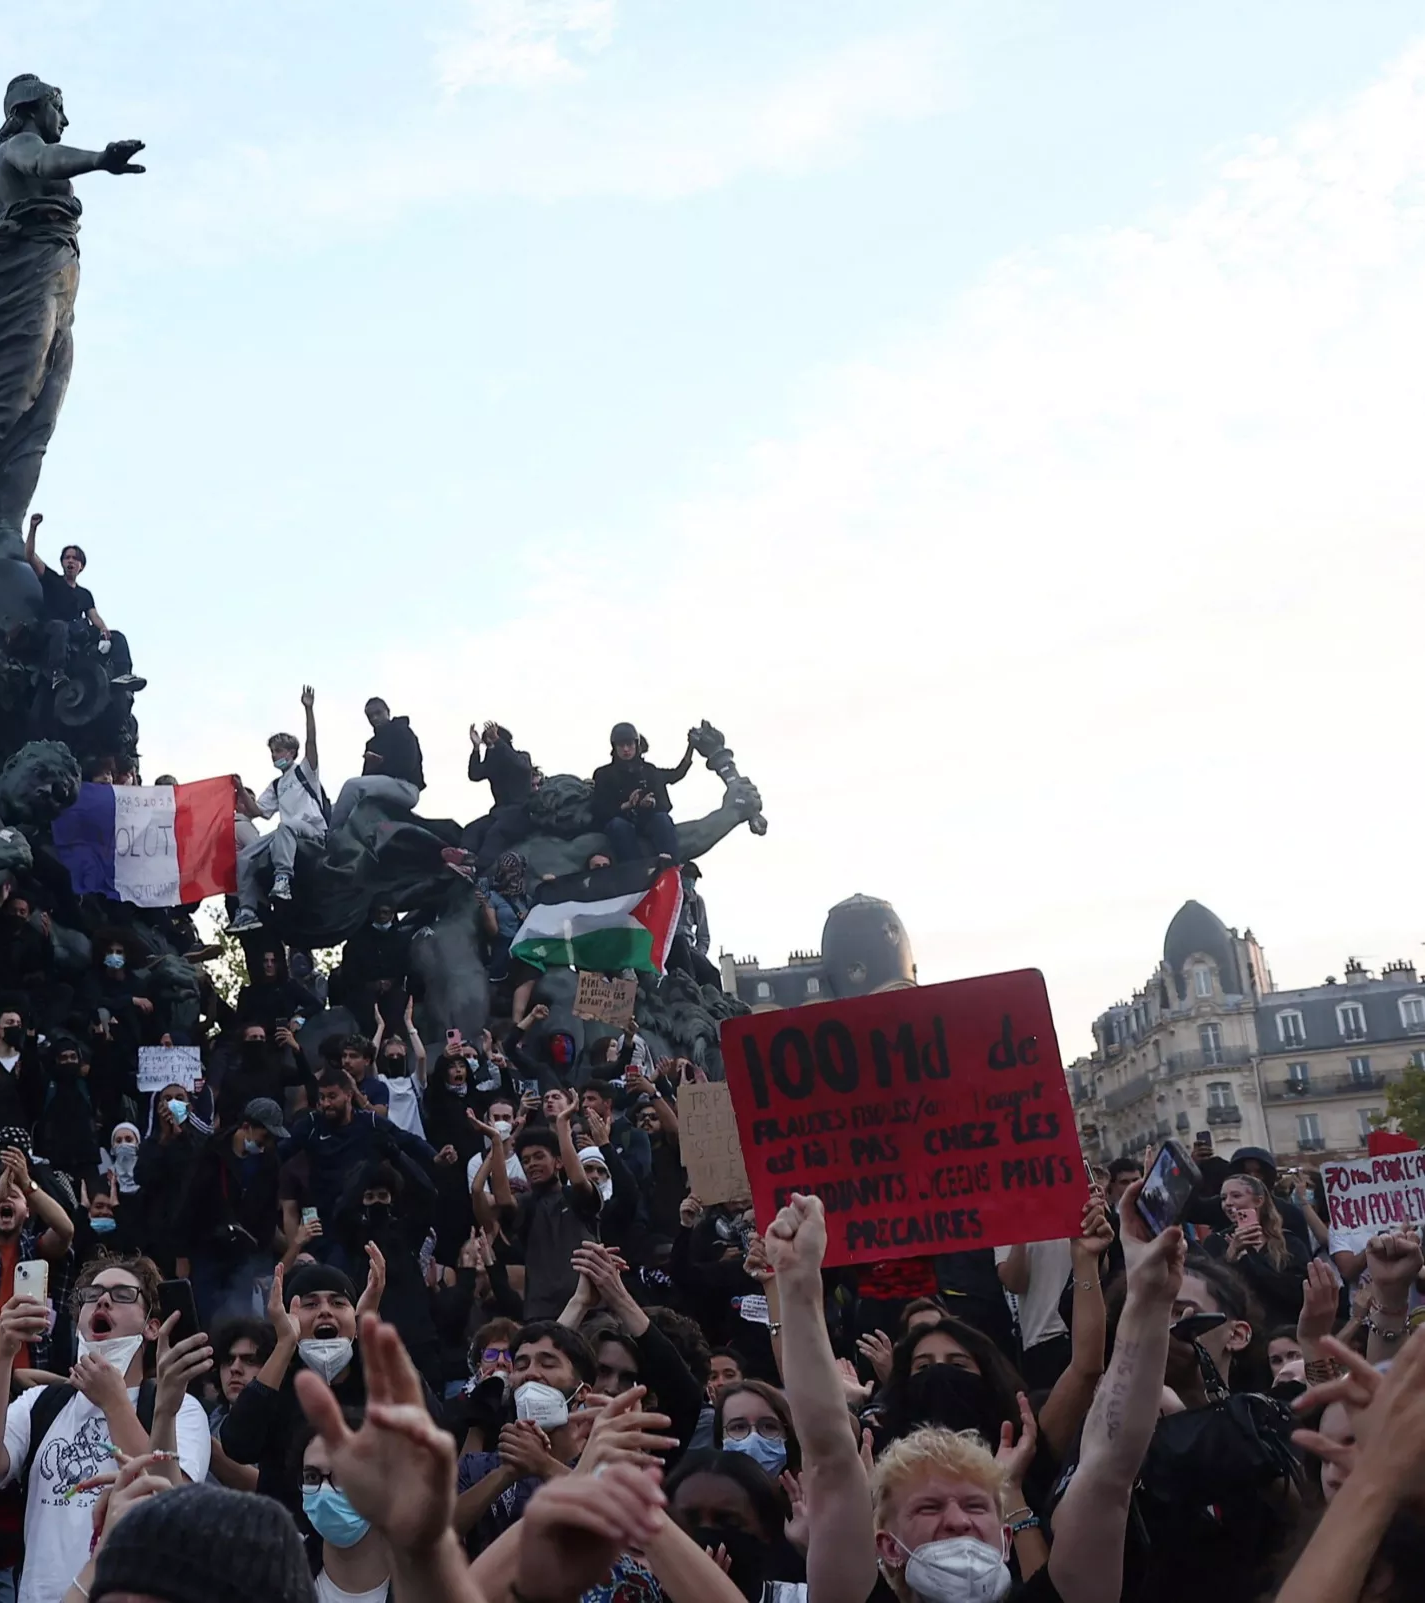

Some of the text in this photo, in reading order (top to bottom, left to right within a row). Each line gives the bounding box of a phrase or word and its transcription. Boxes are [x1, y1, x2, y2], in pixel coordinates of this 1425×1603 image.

[742, 1014, 1040, 1109] 100 Md de
[850, 1135, 900, 1167] PAS
[923, 1122, 1000, 1157] CHEZ
[1011, 1110, 1060, 1144] LES
[1000, 1155, 1072, 1190] PROFS
[1325, 1167, 1351, 1193] 70
[1369, 1190, 1404, 1225] POUR
